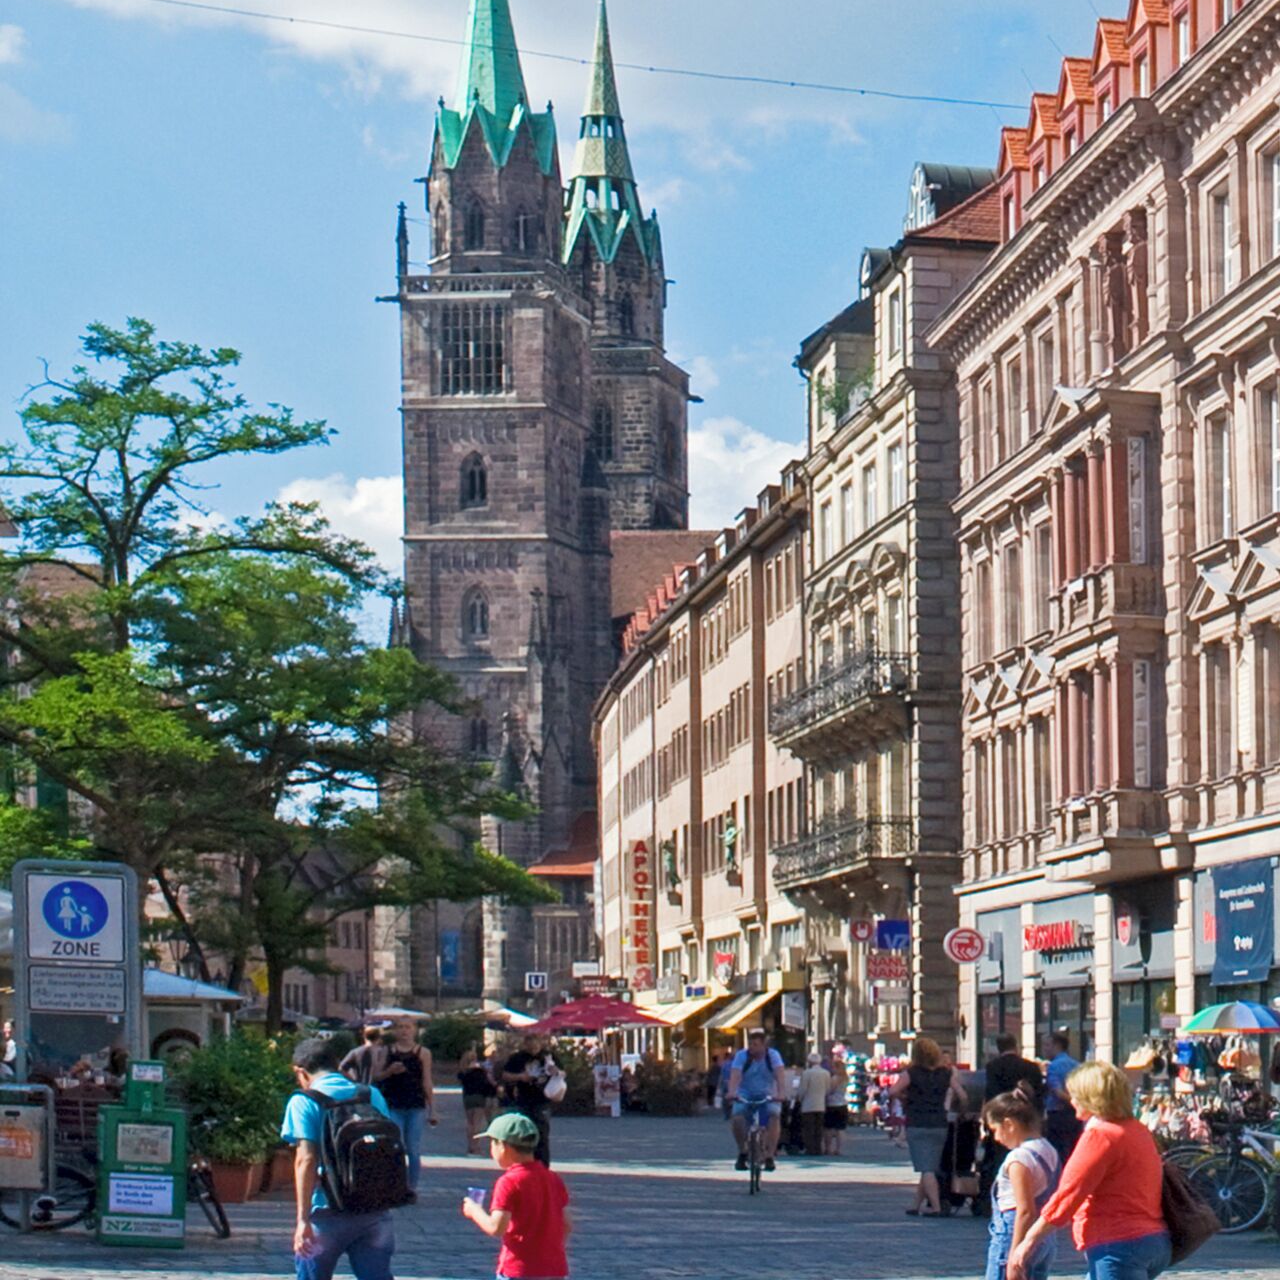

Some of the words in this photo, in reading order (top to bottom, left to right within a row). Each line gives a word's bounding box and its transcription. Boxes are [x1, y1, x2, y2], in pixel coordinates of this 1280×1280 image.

[633, 840, 649, 964] APOTHEKE
[52, 941, 101, 957] ZONE
[531, 975, 543, 988] U
[105, 1220, 133, 1232] NZ
